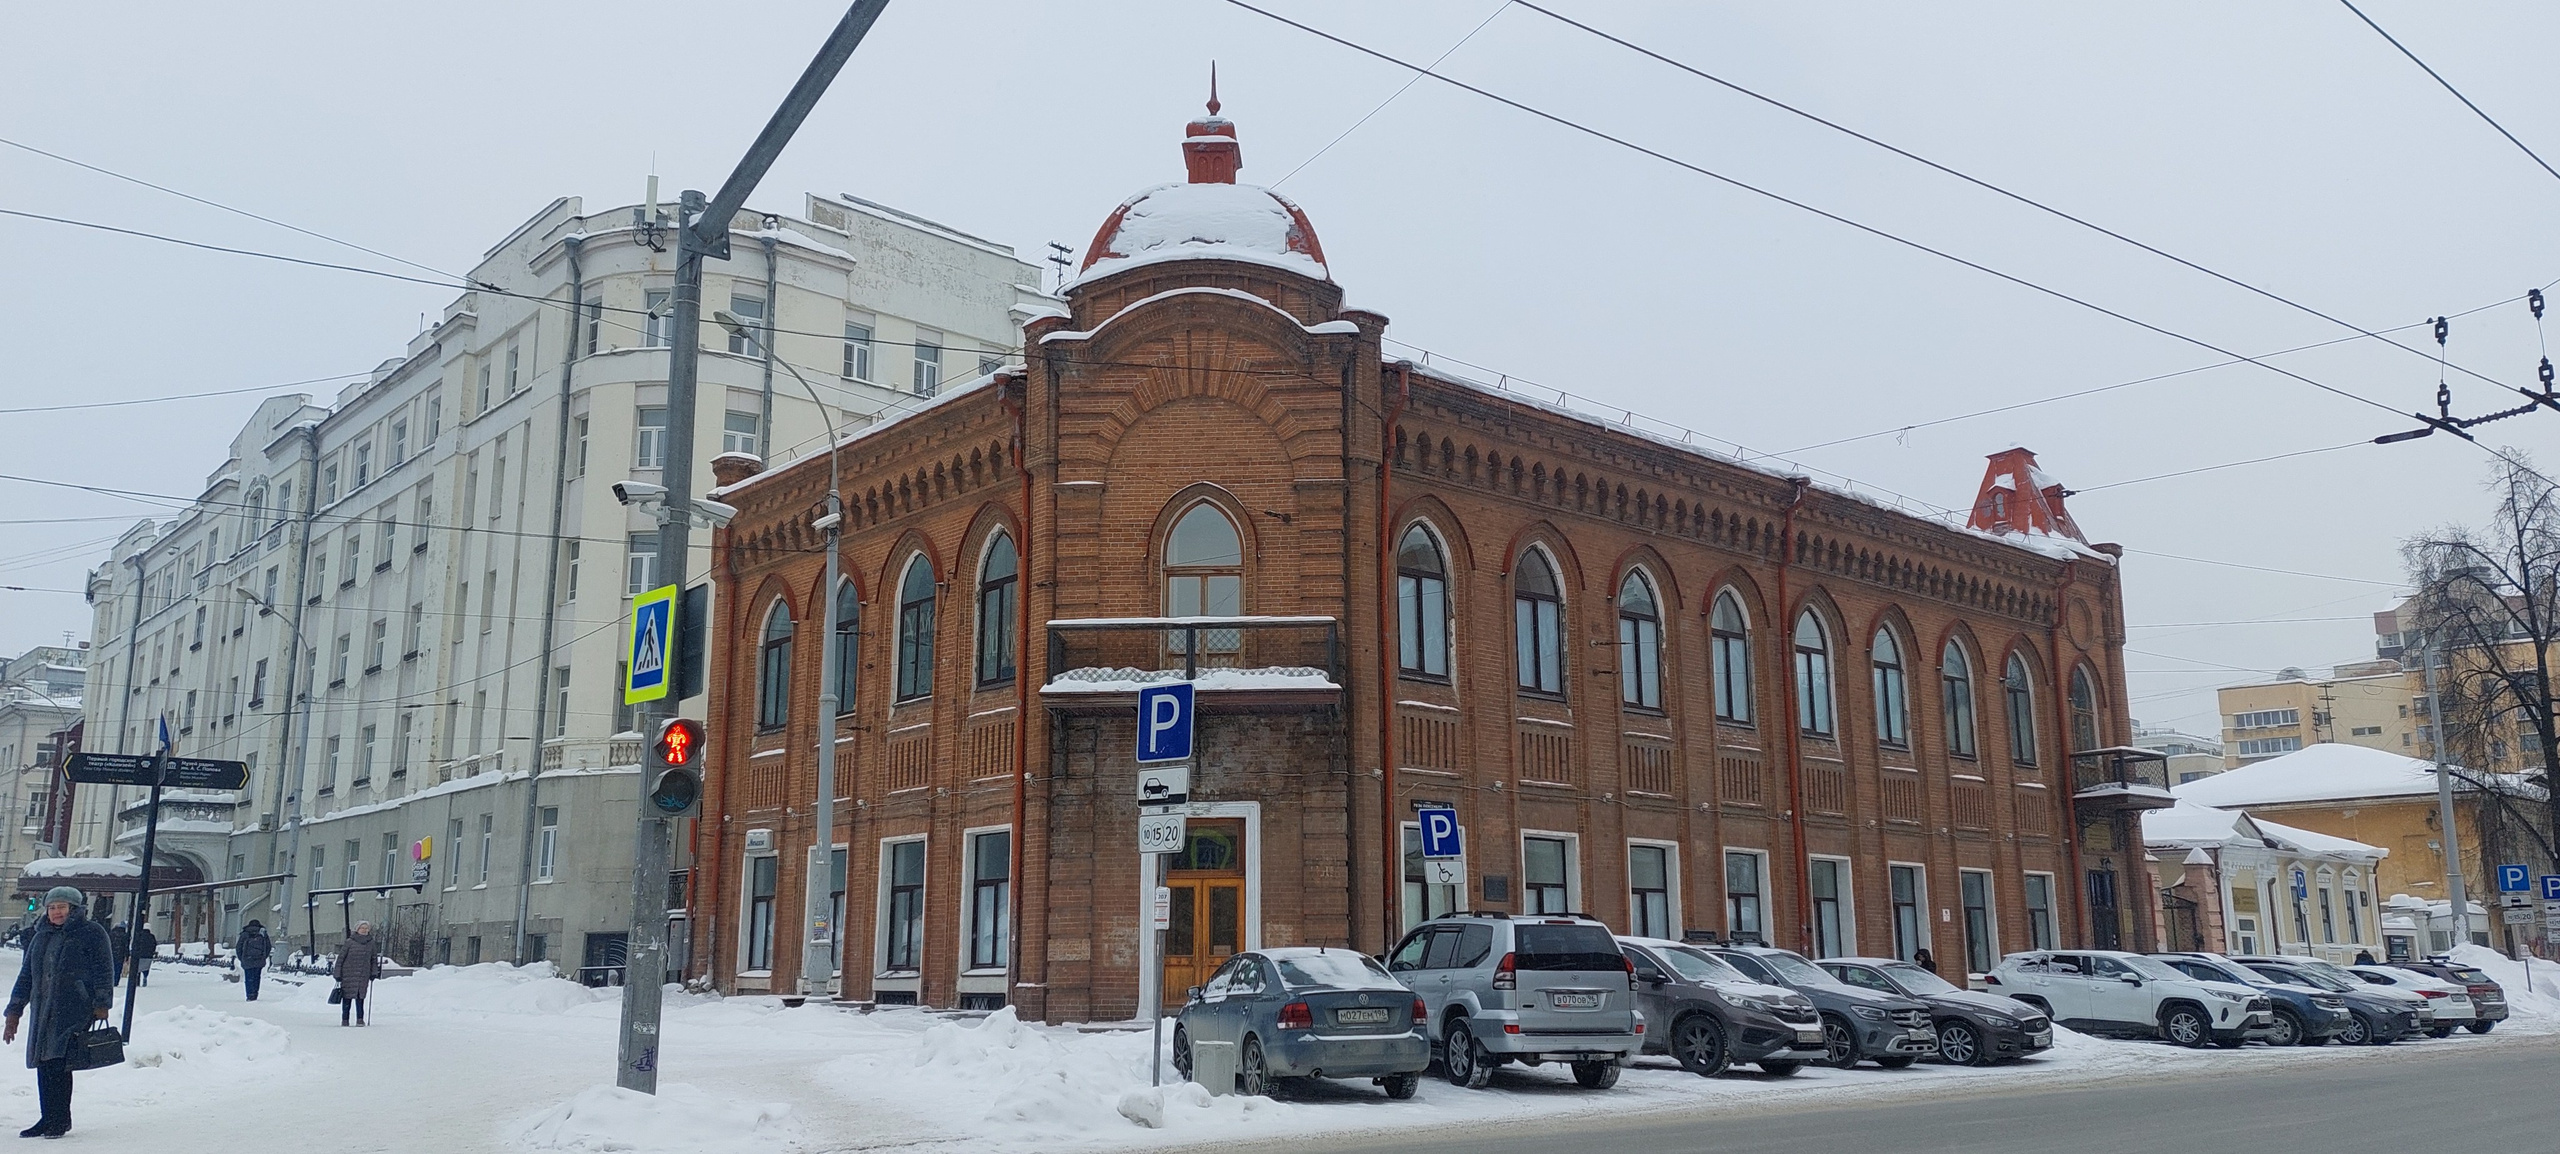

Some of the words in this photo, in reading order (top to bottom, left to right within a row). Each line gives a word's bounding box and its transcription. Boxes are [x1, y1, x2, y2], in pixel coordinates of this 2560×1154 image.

[1150, 693, 1180, 752] P
[1143, 829, 1150, 839] 10
[1153, 828, 1161, 841] 15
[1165, 826, 1178, 842] 20
[1430, 814, 1452, 851] P
[2506, 867, 2524, 889] P
[2546, 877, 2560, 897] P
